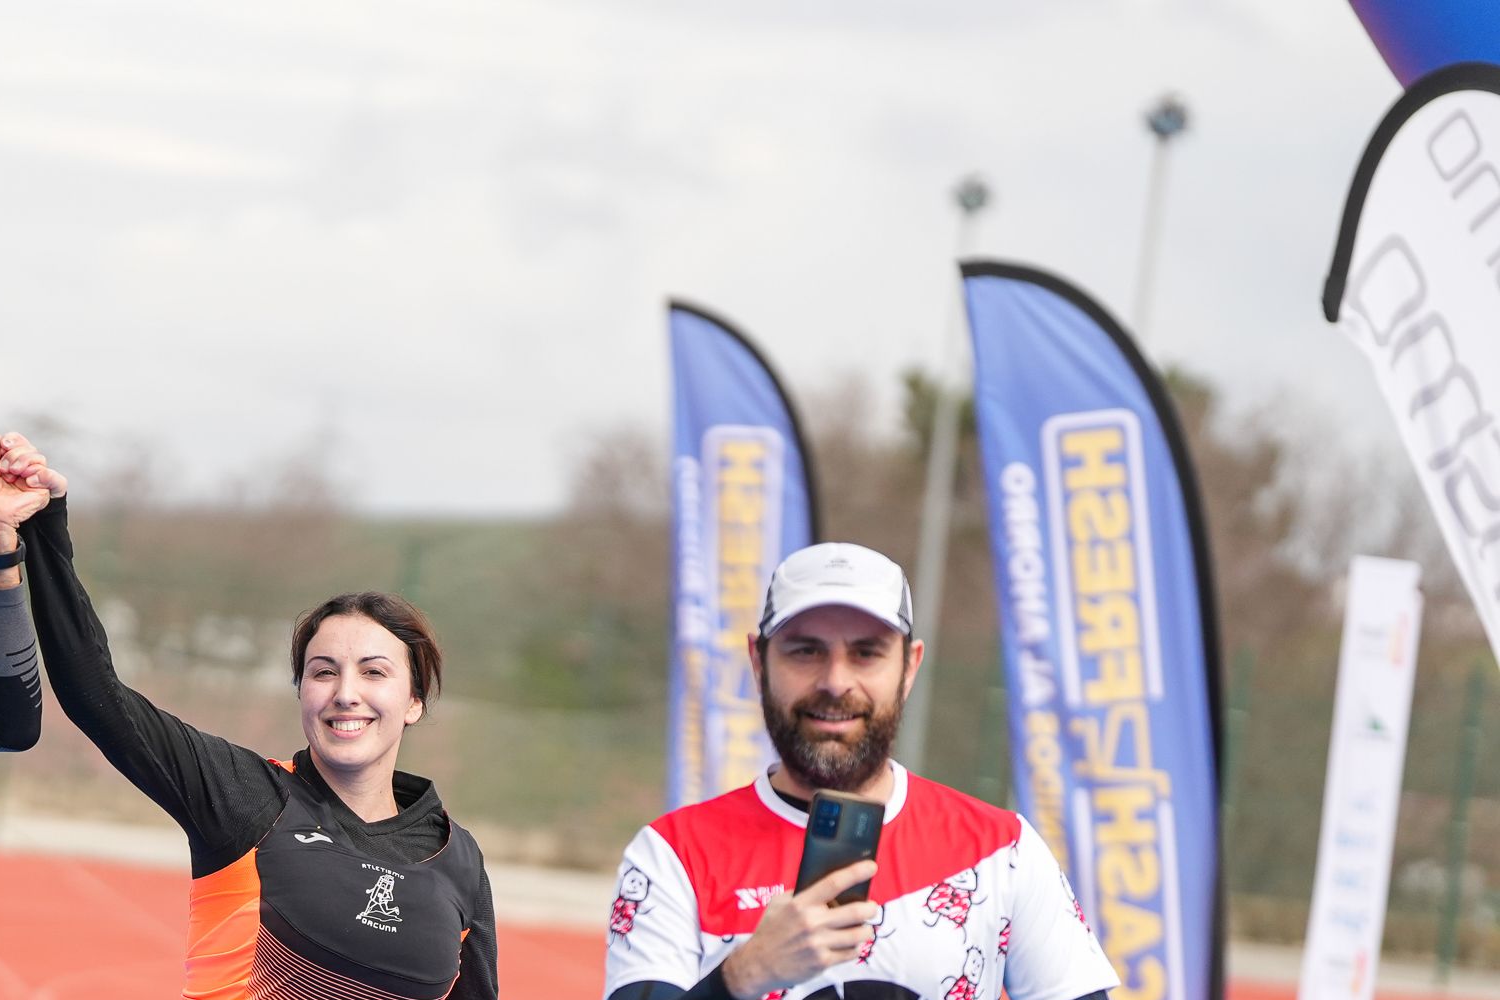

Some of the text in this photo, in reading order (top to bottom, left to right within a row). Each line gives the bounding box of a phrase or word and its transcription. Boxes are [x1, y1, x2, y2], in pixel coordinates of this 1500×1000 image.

[361, 863, 405, 880] ATLETISMO
[757, 883, 785, 897] RUN
[355, 914, 397, 933] PORCUNA
